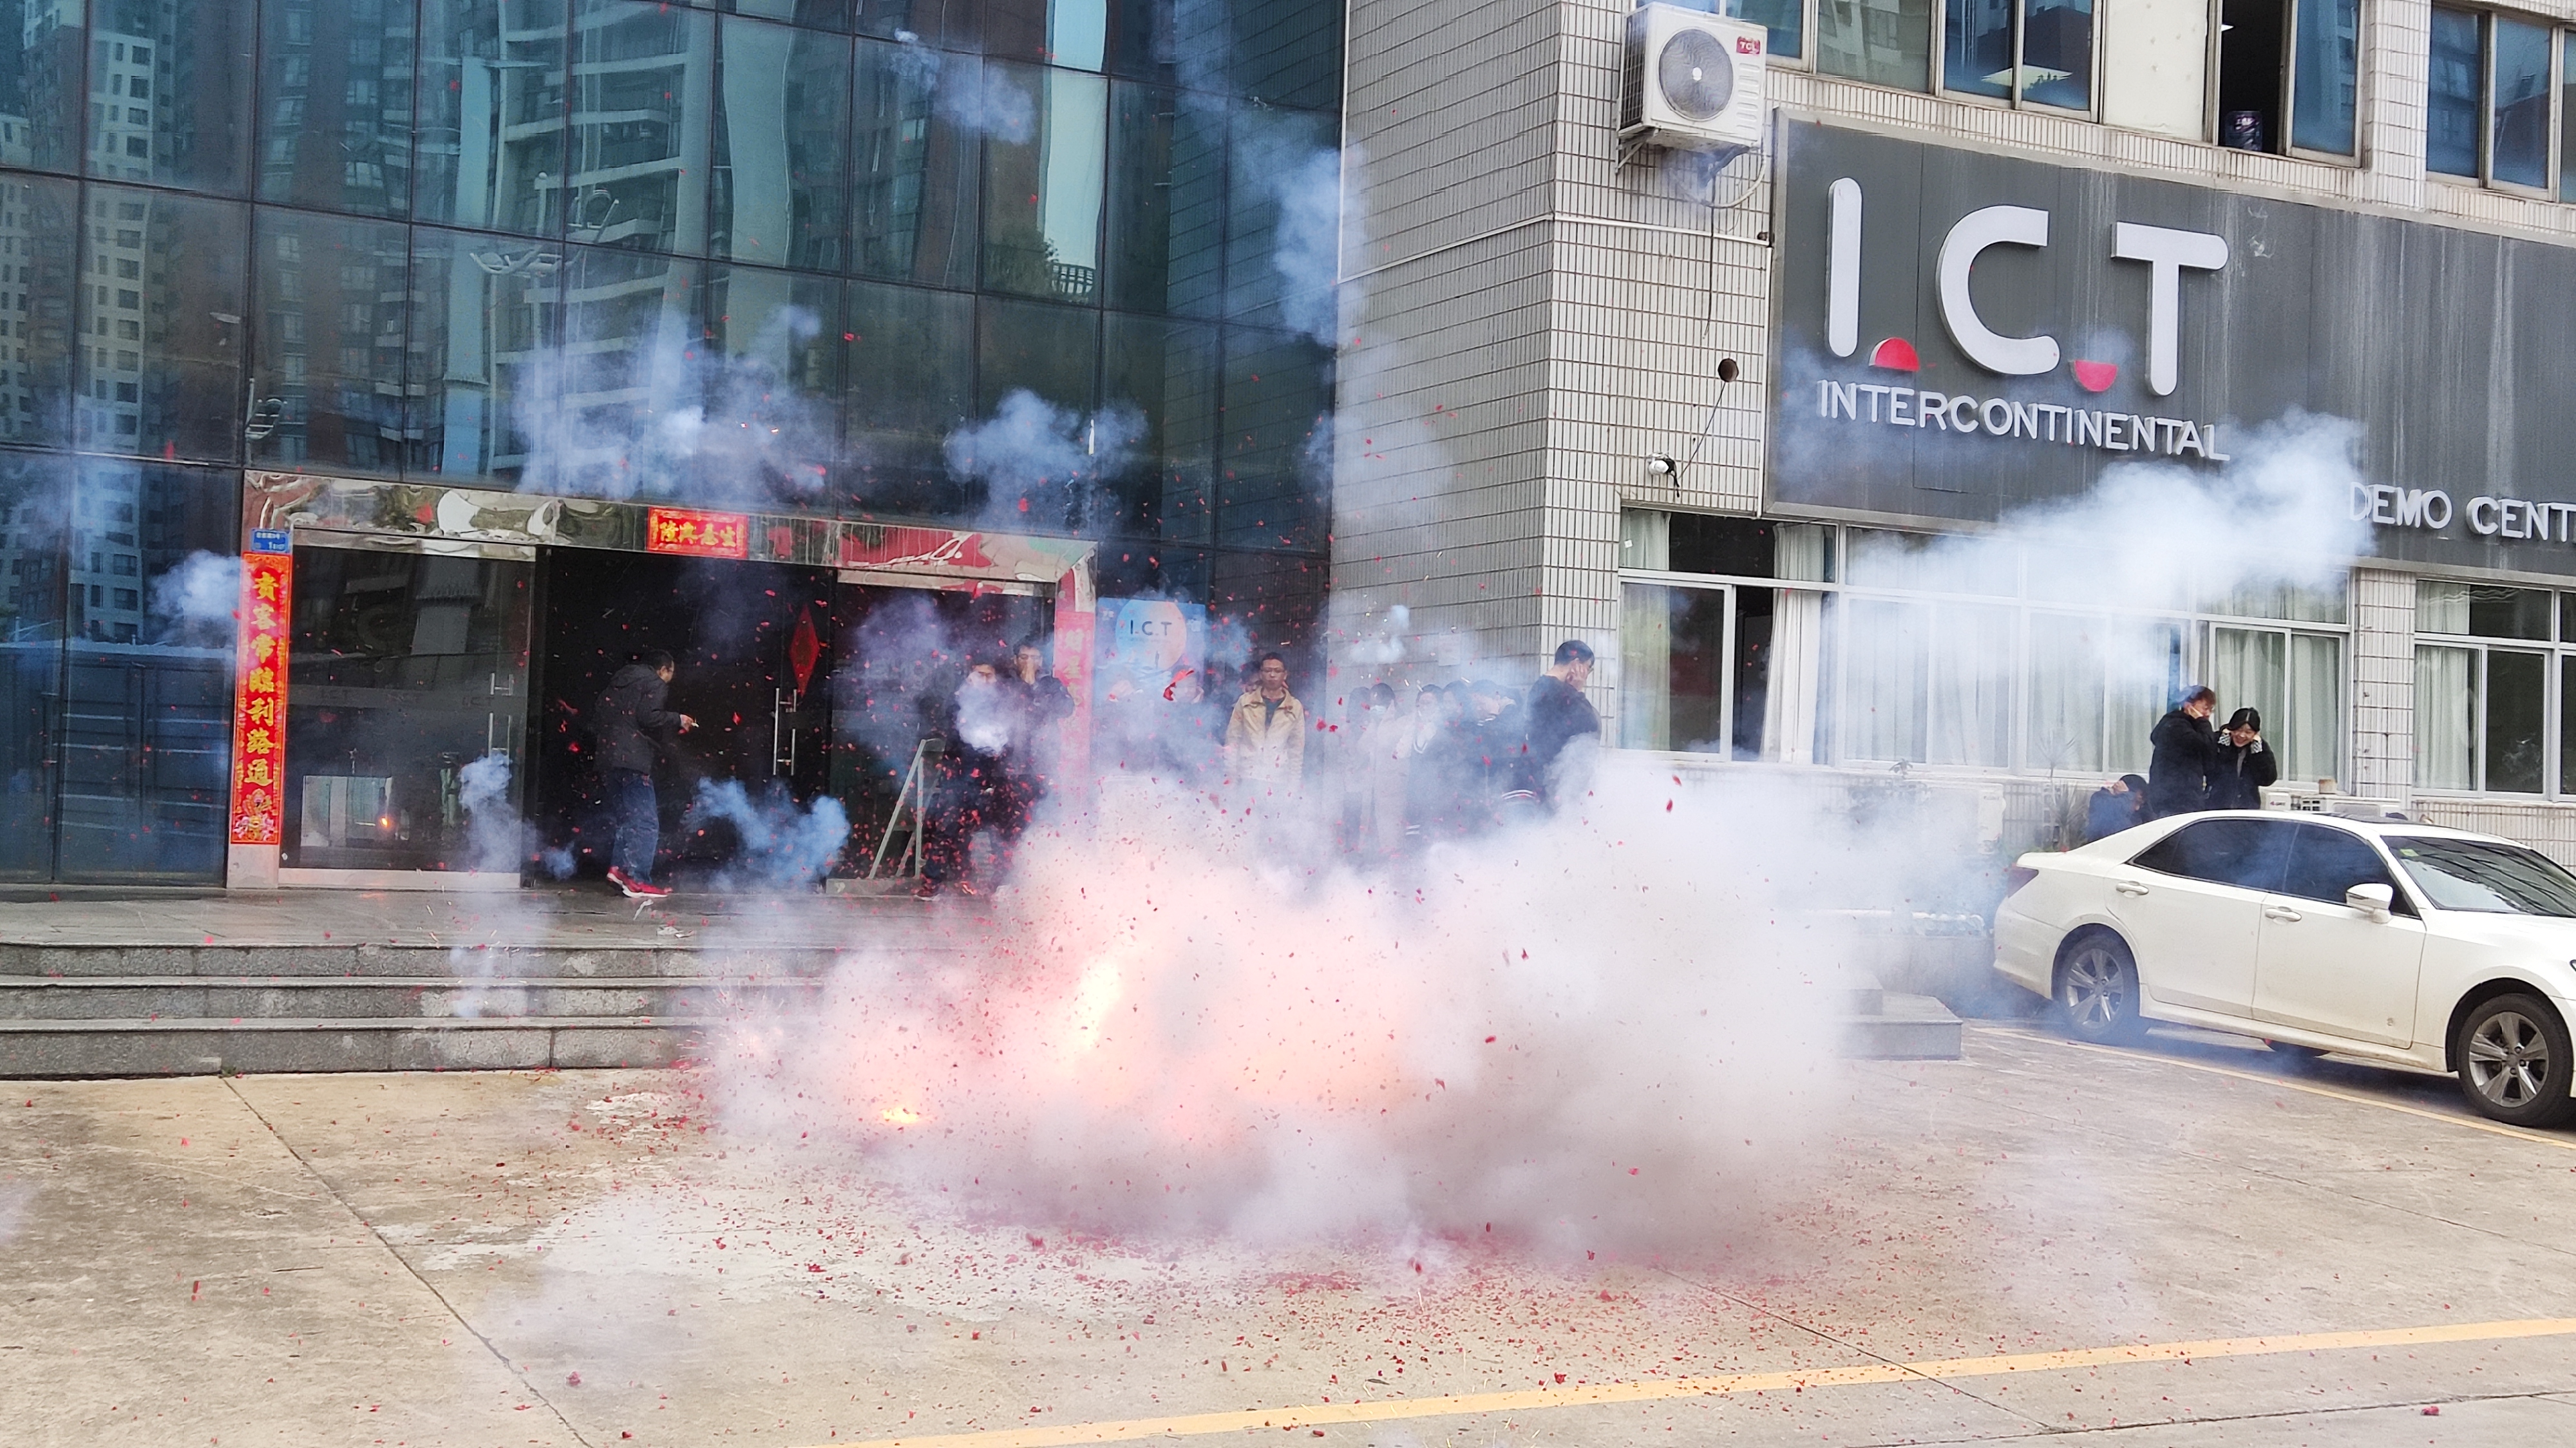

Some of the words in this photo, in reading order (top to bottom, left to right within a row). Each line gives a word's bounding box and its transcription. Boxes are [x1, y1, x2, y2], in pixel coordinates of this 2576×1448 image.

[1739, 41, 1759, 52] TCL
[1816, 379, 2231, 462] INTERCONTINENTAL
[2349, 481, 2453, 529] DEMO
